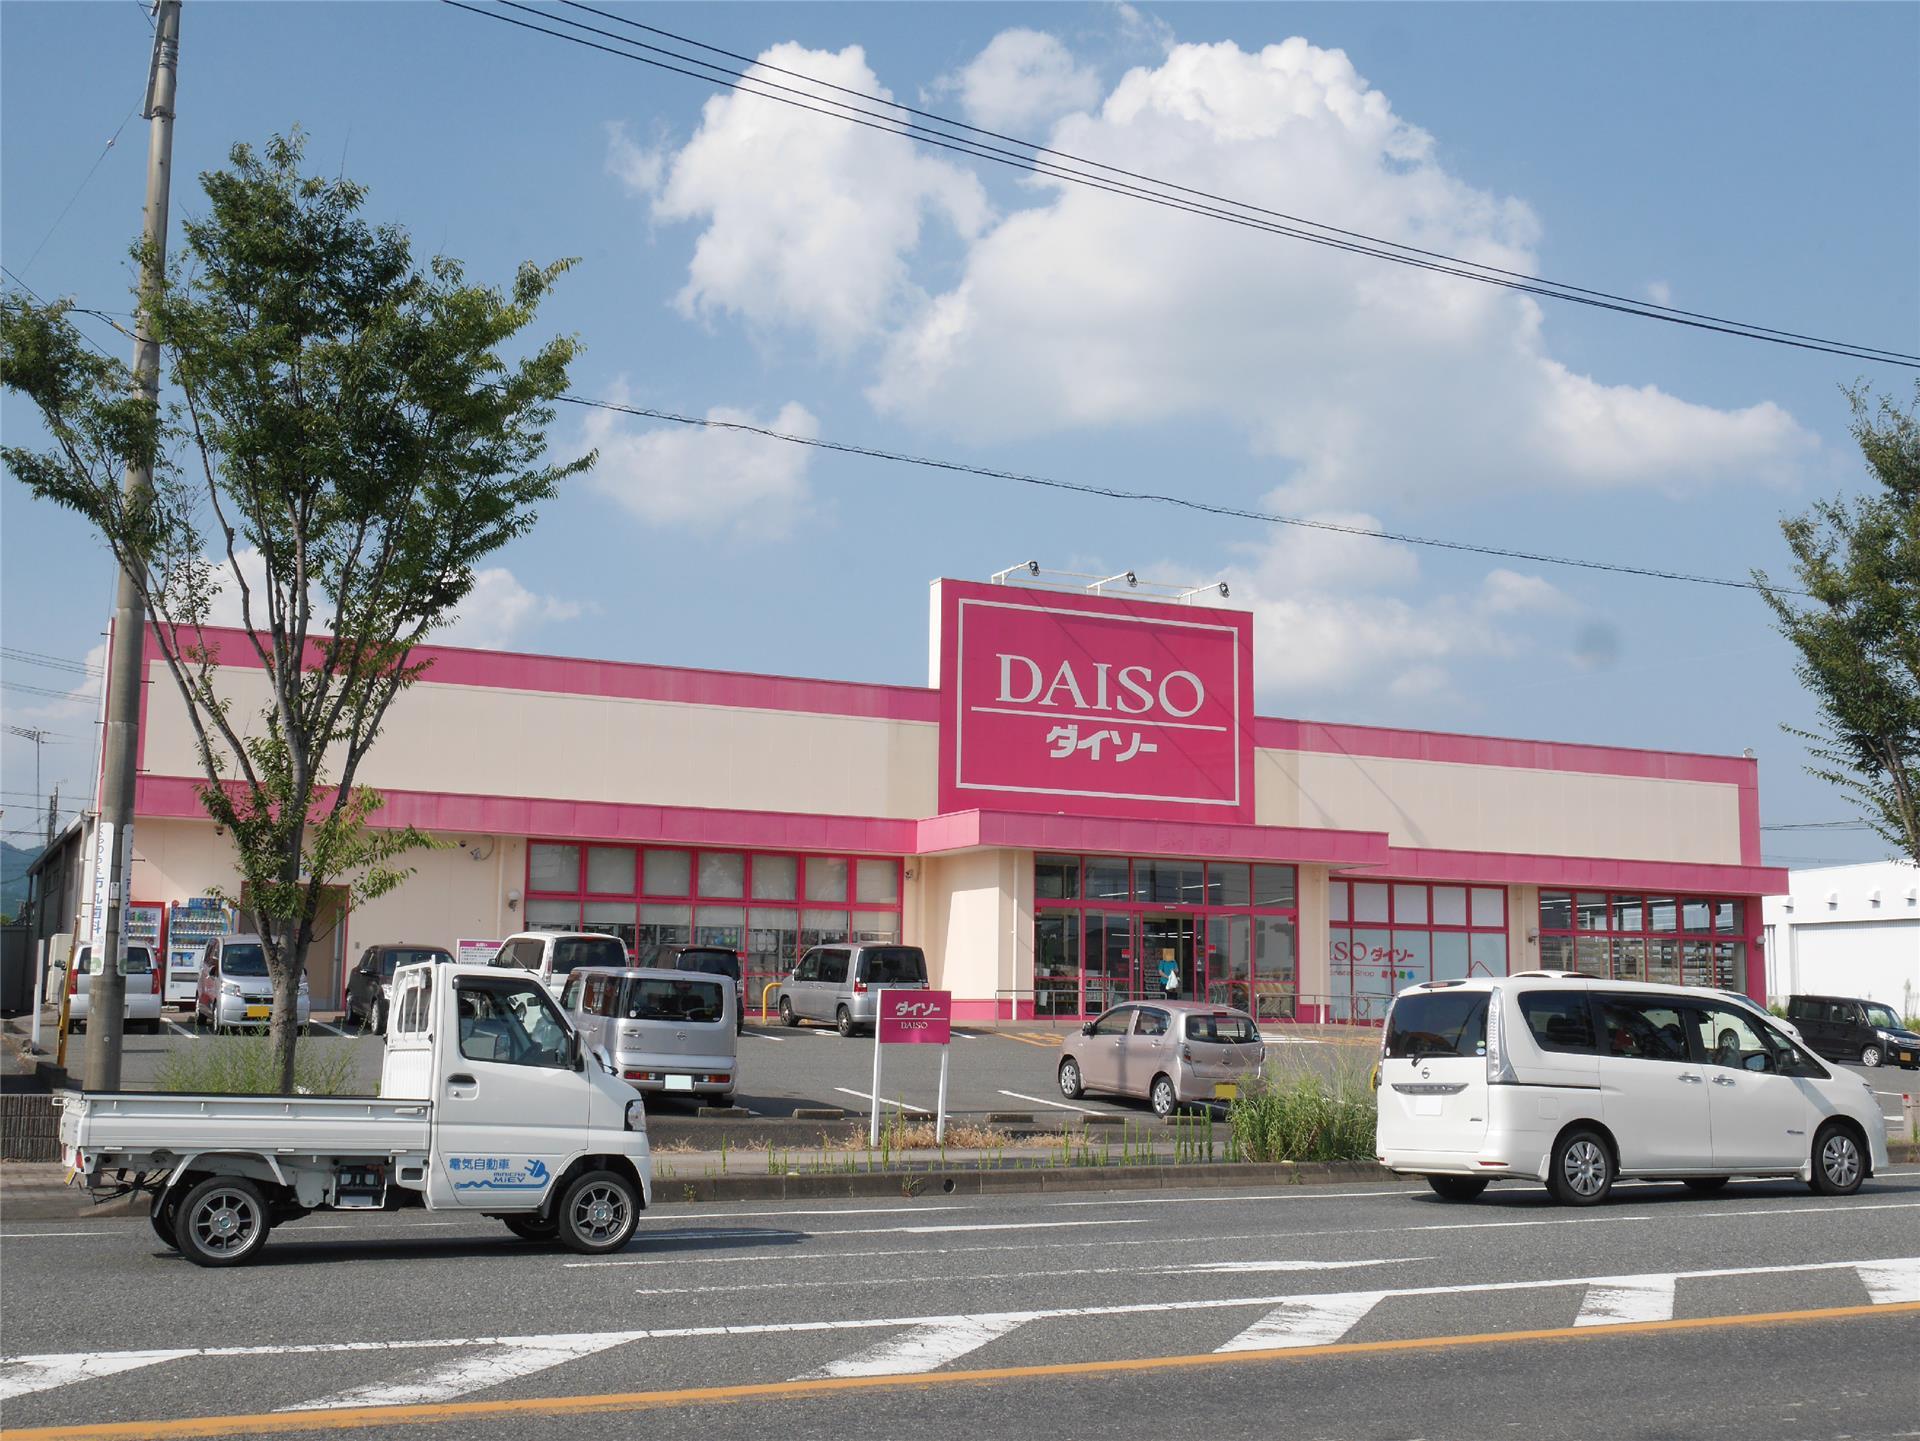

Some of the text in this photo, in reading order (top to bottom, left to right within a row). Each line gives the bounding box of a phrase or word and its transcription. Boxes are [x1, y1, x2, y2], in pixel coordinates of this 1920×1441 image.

[996, 653, 1205, 718] DAISO
[1046, 724, 1158, 762] ダイソー
[896, 1001, 940, 1016] ダイソー
[901, 1021, 928, 1029] DAISO
[449, 1158, 511, 1170] 電気自動車
